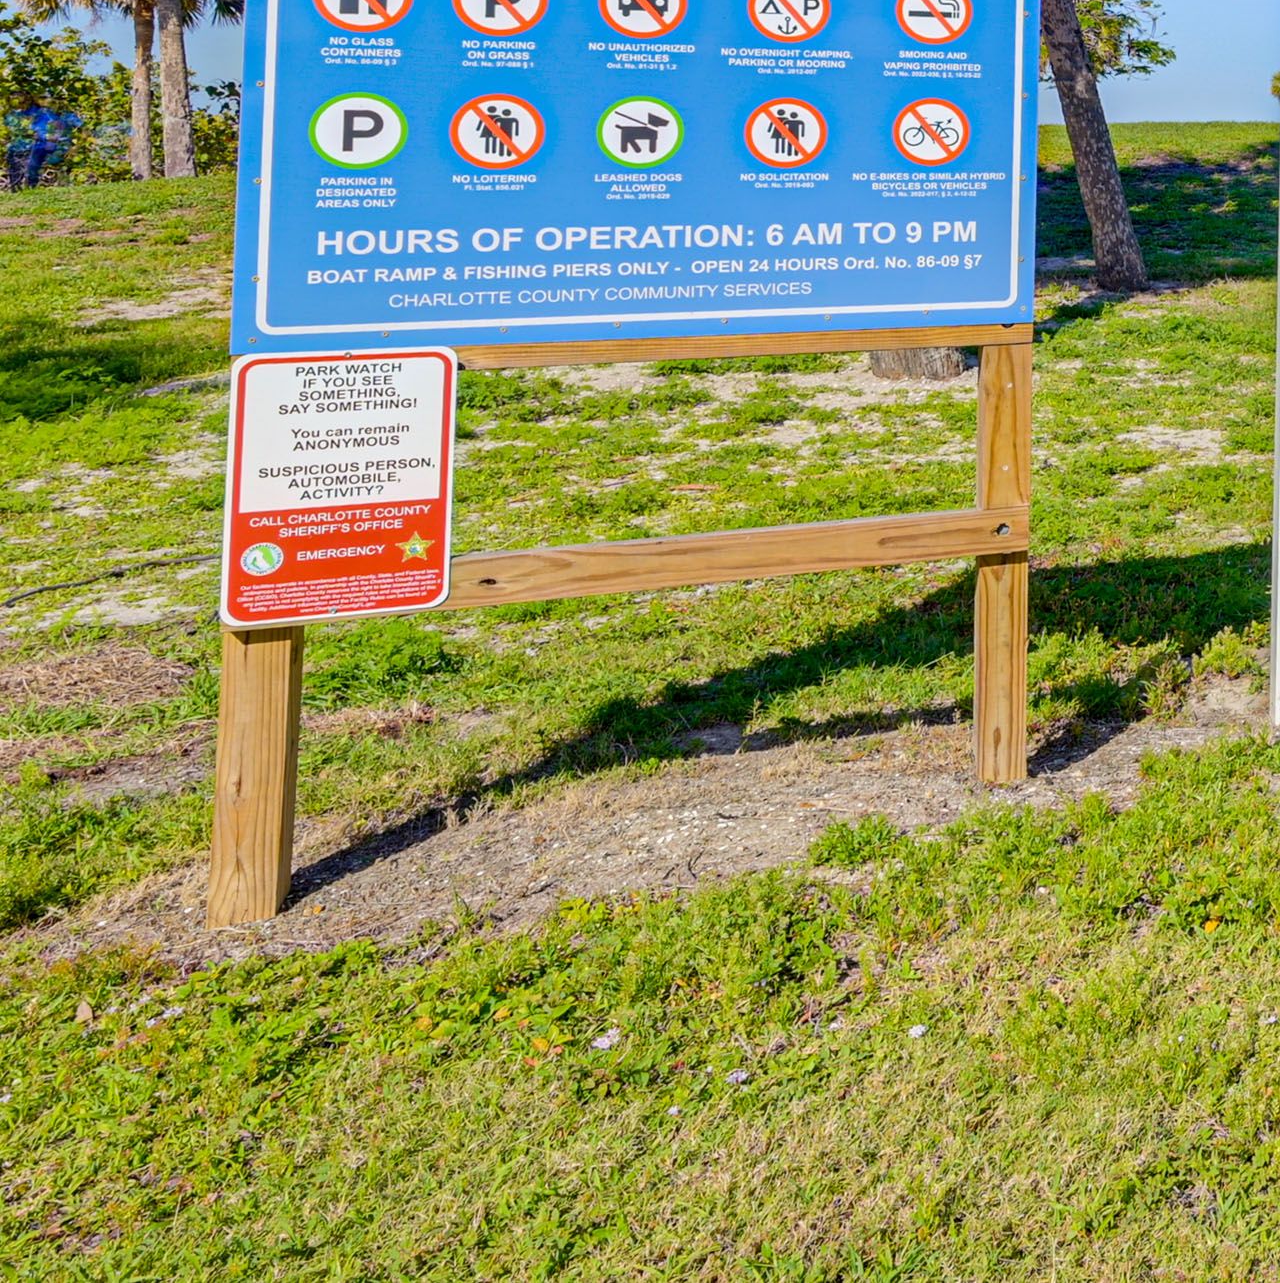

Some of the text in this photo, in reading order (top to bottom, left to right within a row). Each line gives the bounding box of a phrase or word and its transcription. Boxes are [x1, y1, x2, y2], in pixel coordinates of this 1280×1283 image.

[329, 37, 394, 46] NO GLASS
[462, 40, 535, 50] NO PARKING
[588, 42, 695, 52] NO UNAUTHORIZED
[320, 48, 402, 57] CONTAINERS
[468, 51, 530, 60] ON GRASS
[721, 48, 736, 56] NO
[740, 48, 800, 58] OVERNIGHT
[899, 50, 944, 59] SMOKING
[614, 54, 669, 62] VEHICLES
[728, 58, 846, 68] PARKING OR MOORING
[884, 62, 981, 71] VAPING PROHIBITED
[342, 110, 384, 151] P
[453, 175, 536, 183] NO LOITERING
[594, 174, 682, 182] LEASHED DOGS
[740, 173, 829, 181] NO SOLICITATION
[970, 172, 1005, 180] HYBRID
[321, 177, 393, 186] PARKING IN
[872, 182, 987, 190] BICYCLES OR VEHICLES
[316, 188, 396, 197] DESIGNATED
[610, 184, 665, 192] ALLOWED
[315, 199, 396, 208] AREAS ONLY
[317, 221, 977, 256] HOURS OF OPERATION: 6 AM TO 9 PM
[307, 269, 367, 285] BOAT
[374, 267, 437, 282] RAMP
[443, 267, 457, 280] &
[464, 266, 546, 279] FISHING
[553, 264, 611, 277] PIERS
[618, 261, 669, 276] ONLY
[692, 260, 743, 274] OPEN
[749, 260, 769, 272] 24
[775, 257, 838, 271] HOURS
[844, 257, 879, 270] Ord.
[885, 256, 911, 269] No.
[917, 255, 959, 267] 86-09
[964, 254, 982, 270] §7
[389, 282, 812, 308] CHARLOTTE COUNTY COMMUNITY SERVICES
[296, 362, 402, 377] PARK WATCH
[303, 376, 393, 388] IF YOU SEE
[299, 388, 400, 402] SOMETHING,
[278, 398, 418, 416] SAY SOMETHING!
[292, 424, 410, 439] You can remain
[293, 436, 400, 451] ANONYMOUS
[258, 458, 436, 478] SUSPICIOUS PERSON,
[288, 472, 401, 490] AUTOMOBILE,
[300, 486, 384, 500] ACTIVITY?
[250, 505, 432, 528] CALL CHARLOTTE COUNTY
[278, 520, 403, 538] SHERIFF'S OFFICE
[296, 545, 385, 561] EMERGENCY
